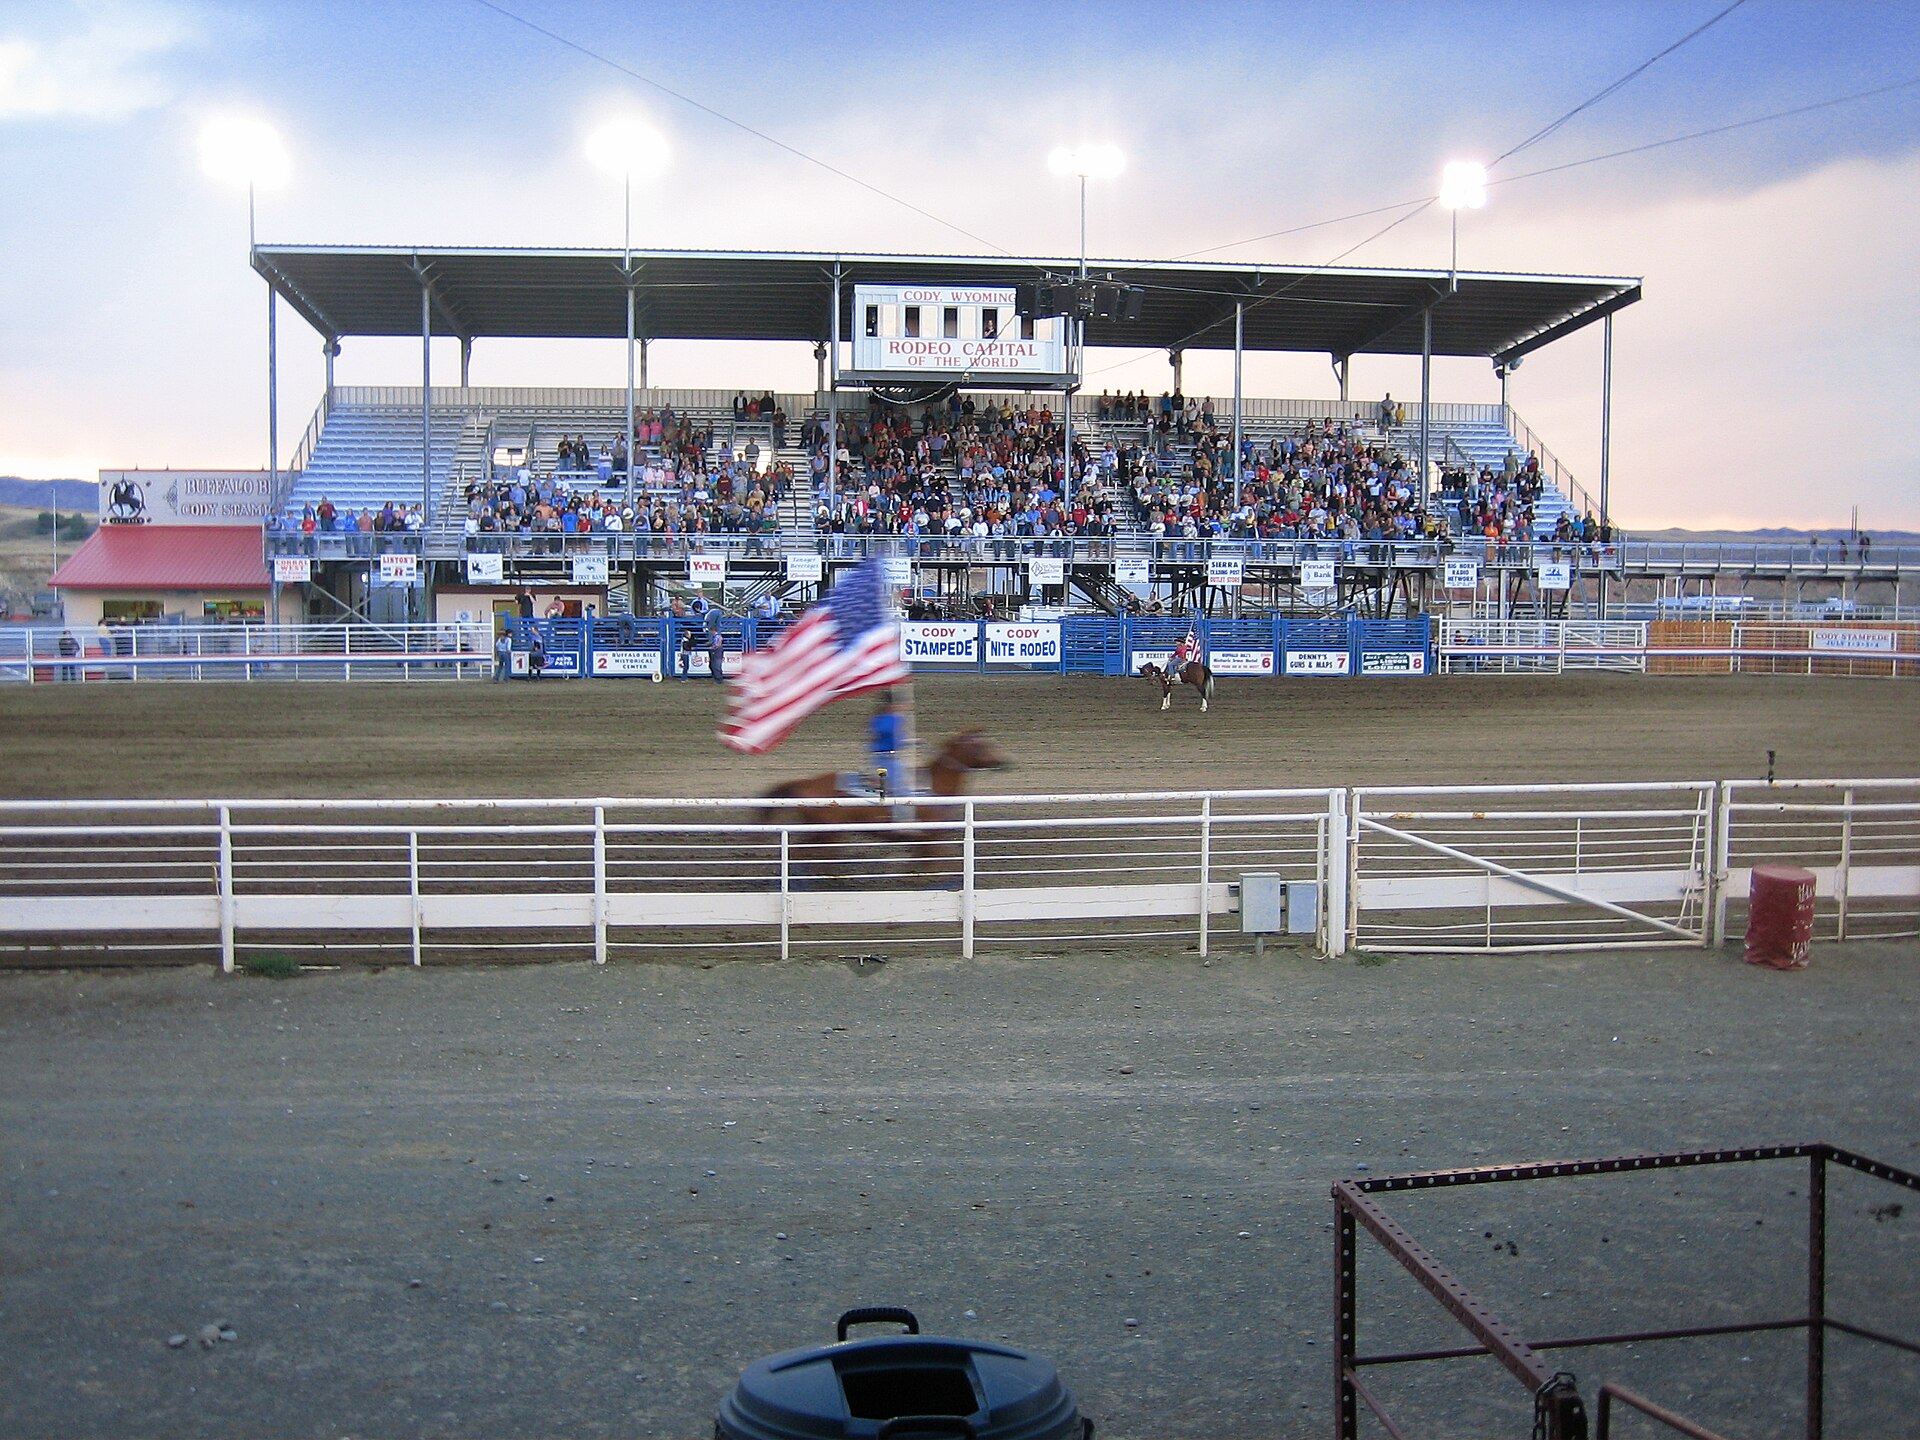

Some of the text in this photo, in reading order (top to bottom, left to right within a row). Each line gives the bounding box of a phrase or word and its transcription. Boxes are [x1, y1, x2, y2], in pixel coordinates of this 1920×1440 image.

[951, 291, 1016, 303] WYOMING
[889, 341, 1038, 357] RODEO CAPITAL
[908, 355, 1019, 368] OF THE WORLD
[185, 478, 253, 495] BUFFALO
[181, 503, 218, 516] CODY
[922, 628, 956, 637] CODY
[1007, 629, 1040, 638] CODY
[1841, 633, 1889, 641] STAMPEDE
[905, 638, 973, 656] STAMPEDE
[990, 640, 1056, 657] NITE RODEO
[516, 657, 523, 670] 1
[598, 657, 608, 670] 2
[1262, 657, 1271, 669] 6
[1337, 657, 1346, 669] 7
[1413, 658, 1422, 669] 8
